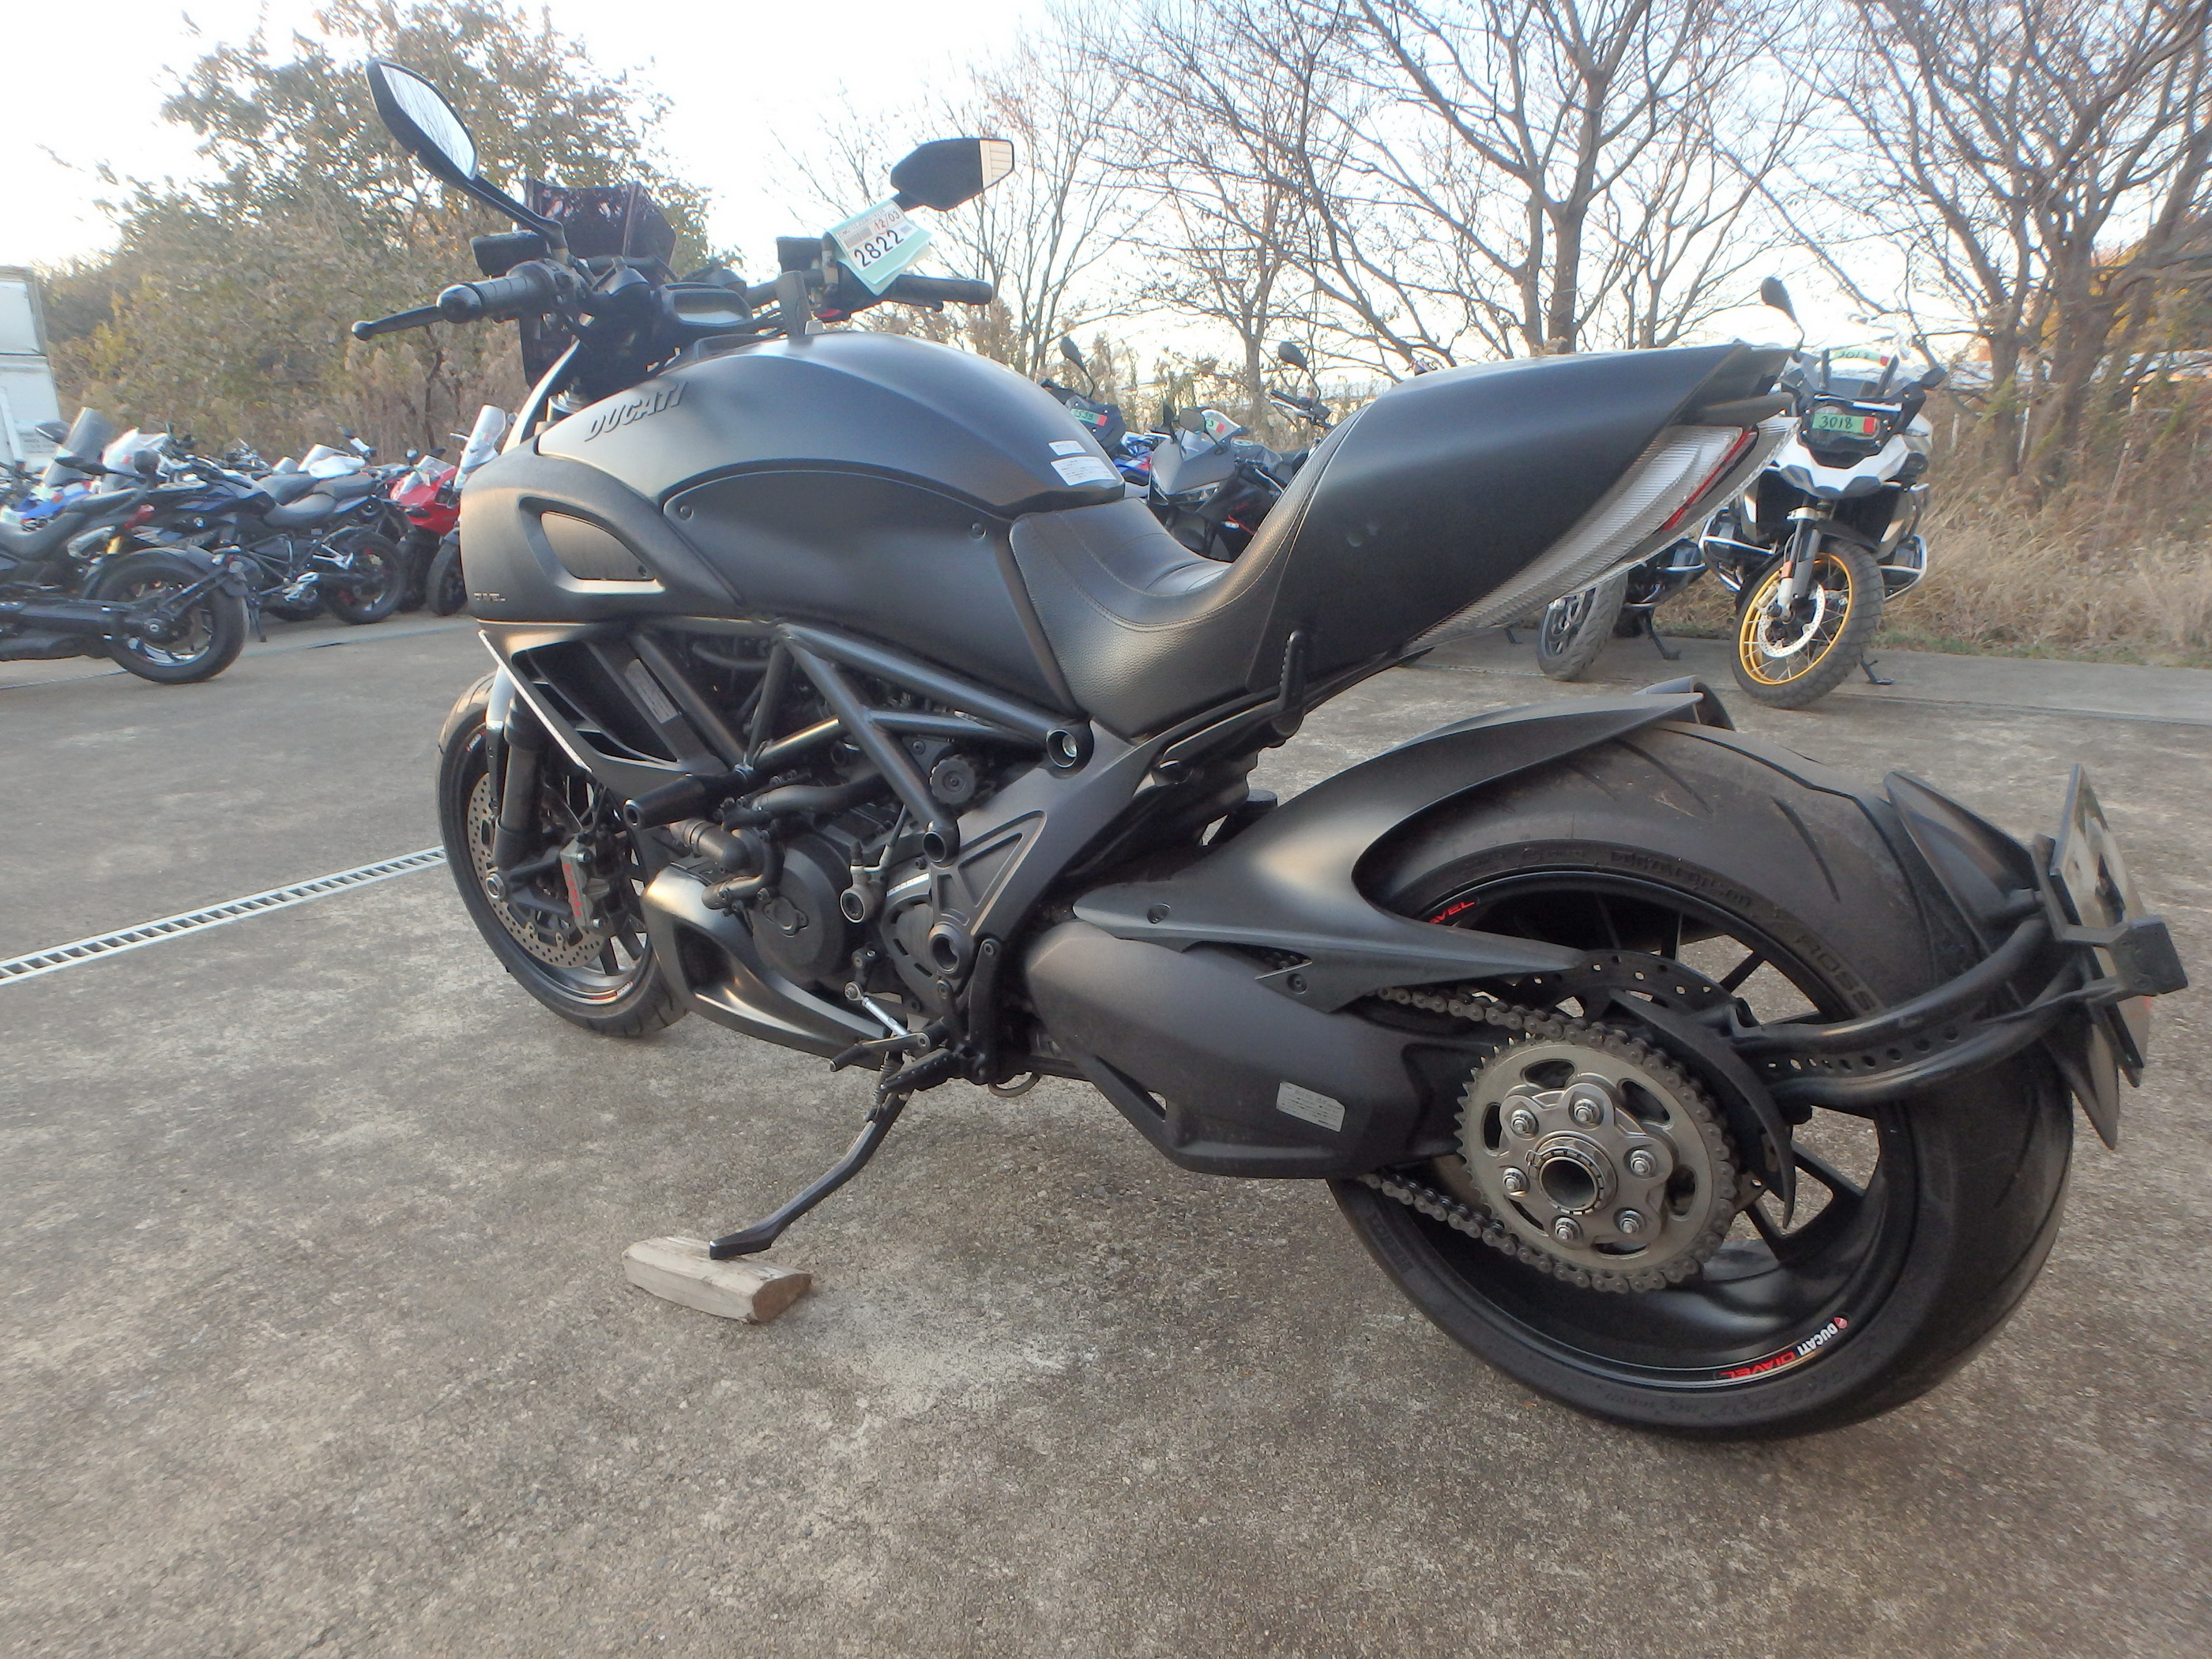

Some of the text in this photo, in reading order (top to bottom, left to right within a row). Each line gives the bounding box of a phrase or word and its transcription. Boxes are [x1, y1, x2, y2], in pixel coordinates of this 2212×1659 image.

[874, 210, 901, 231] 12/03
[854, 229, 905, 268] 2822
[585, 382, 689, 442] DUCATI
[1819, 416, 1853, 429] 3018
[1719, 1322, 1839, 1379] DUCATI DIAVEL
